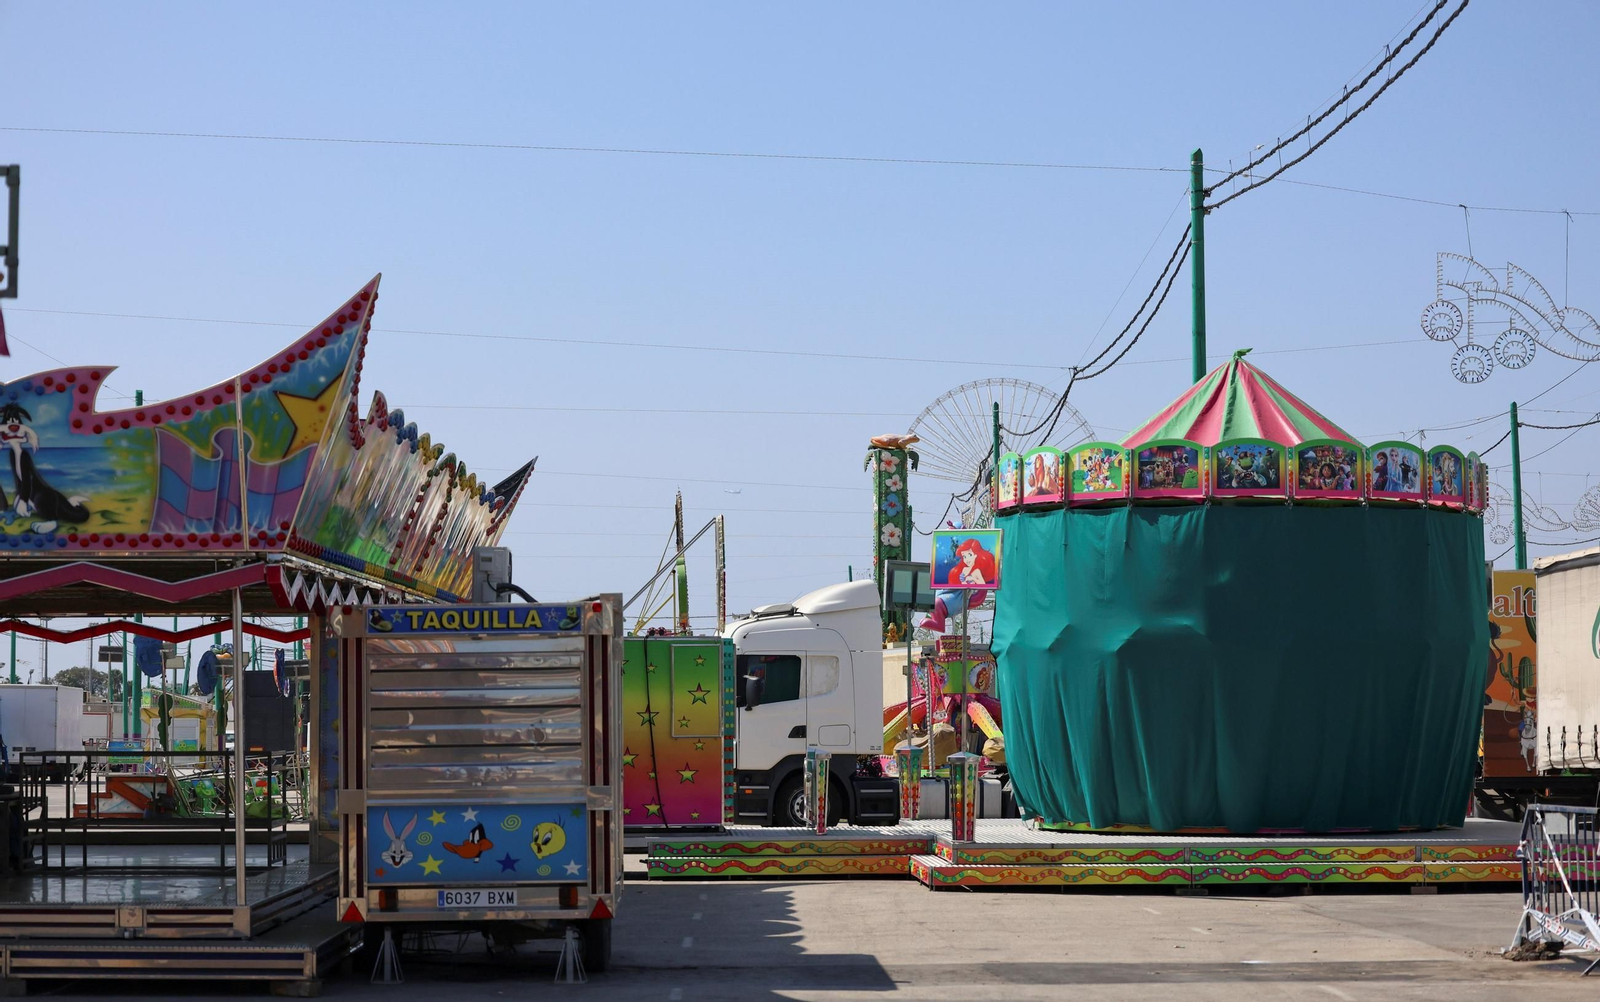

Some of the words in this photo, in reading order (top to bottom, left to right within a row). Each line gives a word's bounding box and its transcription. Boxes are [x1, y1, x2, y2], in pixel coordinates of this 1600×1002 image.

[1492, 585, 1537, 618] alt
[406, 609, 543, 631] TAQUILLA
[445, 891, 481, 905] 6037
[488, 891, 514, 905] BXM
